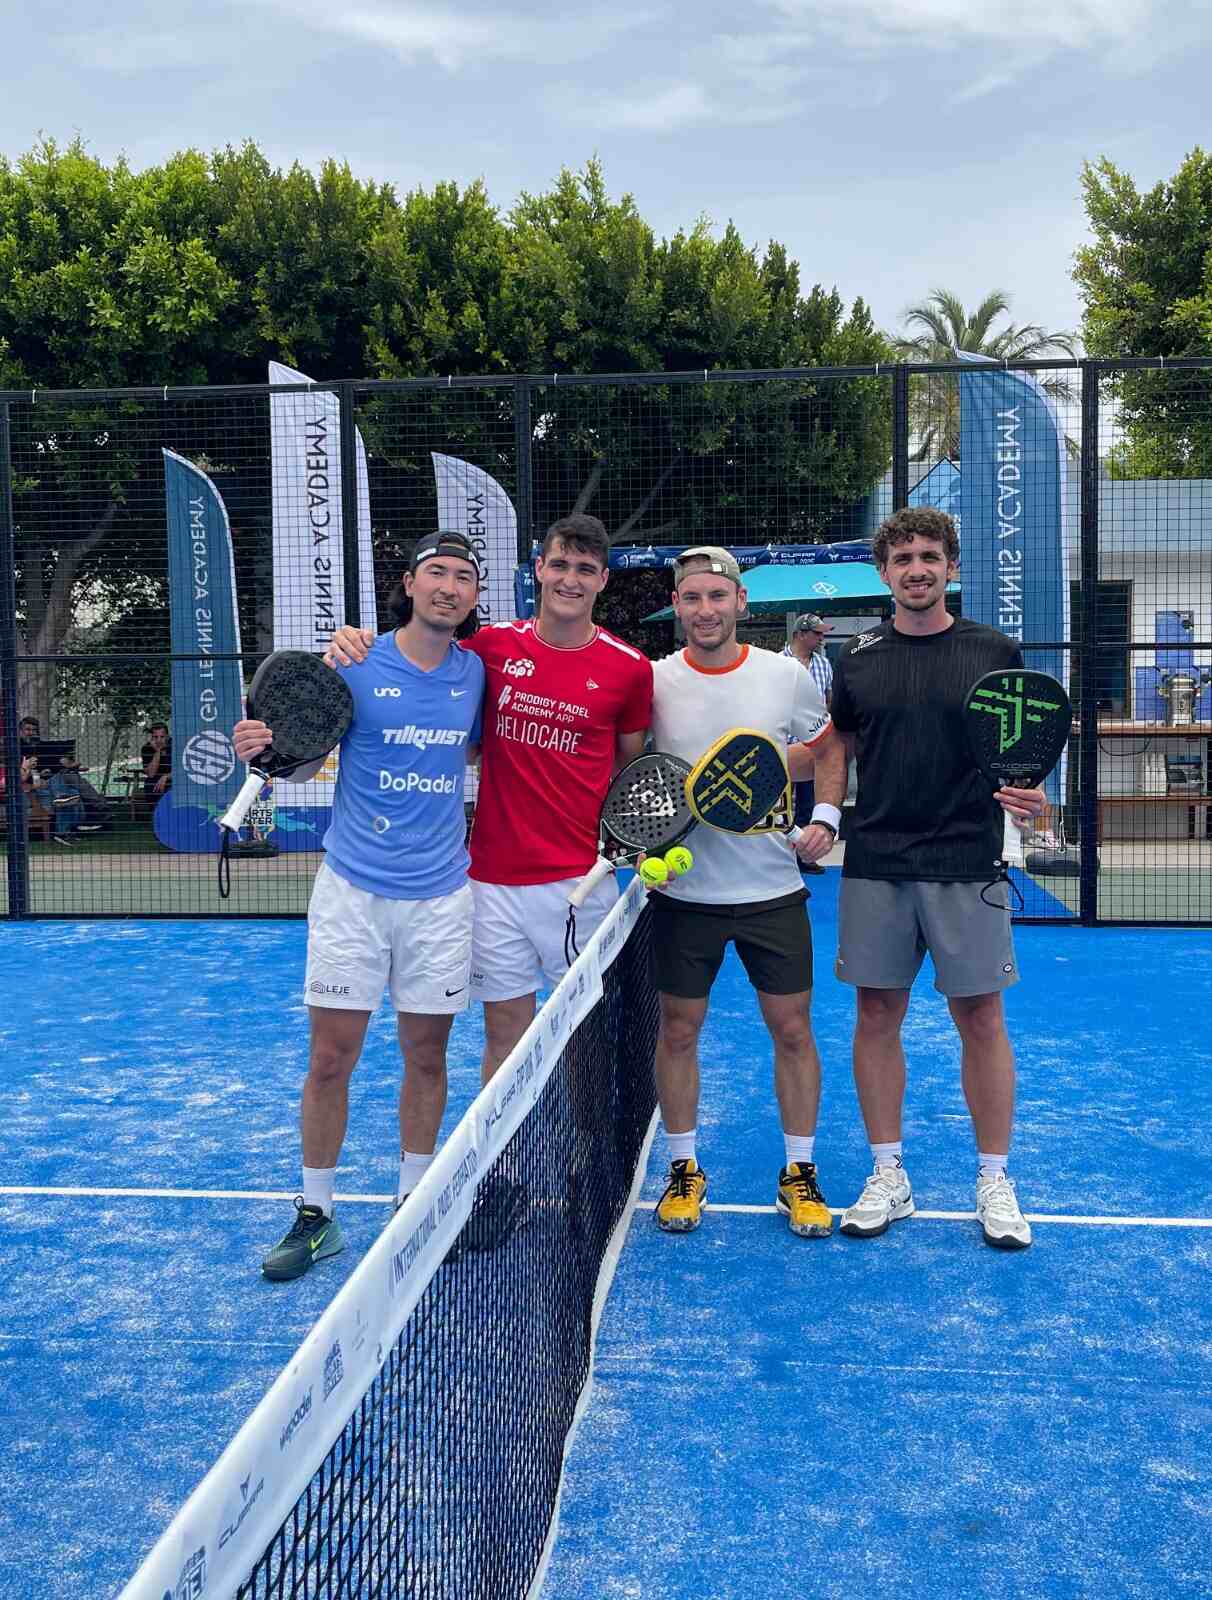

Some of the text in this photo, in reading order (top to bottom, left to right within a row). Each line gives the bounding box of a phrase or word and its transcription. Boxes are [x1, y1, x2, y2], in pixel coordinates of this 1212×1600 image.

[374, 687, 402, 697] uno
[511, 702, 575, 724] ACADEMY APP
[513, 691, 590, 719] PRODIGY PADEL
[496, 713, 583, 755] HELIOCARE
[379, 770, 457, 794] DoPadel
